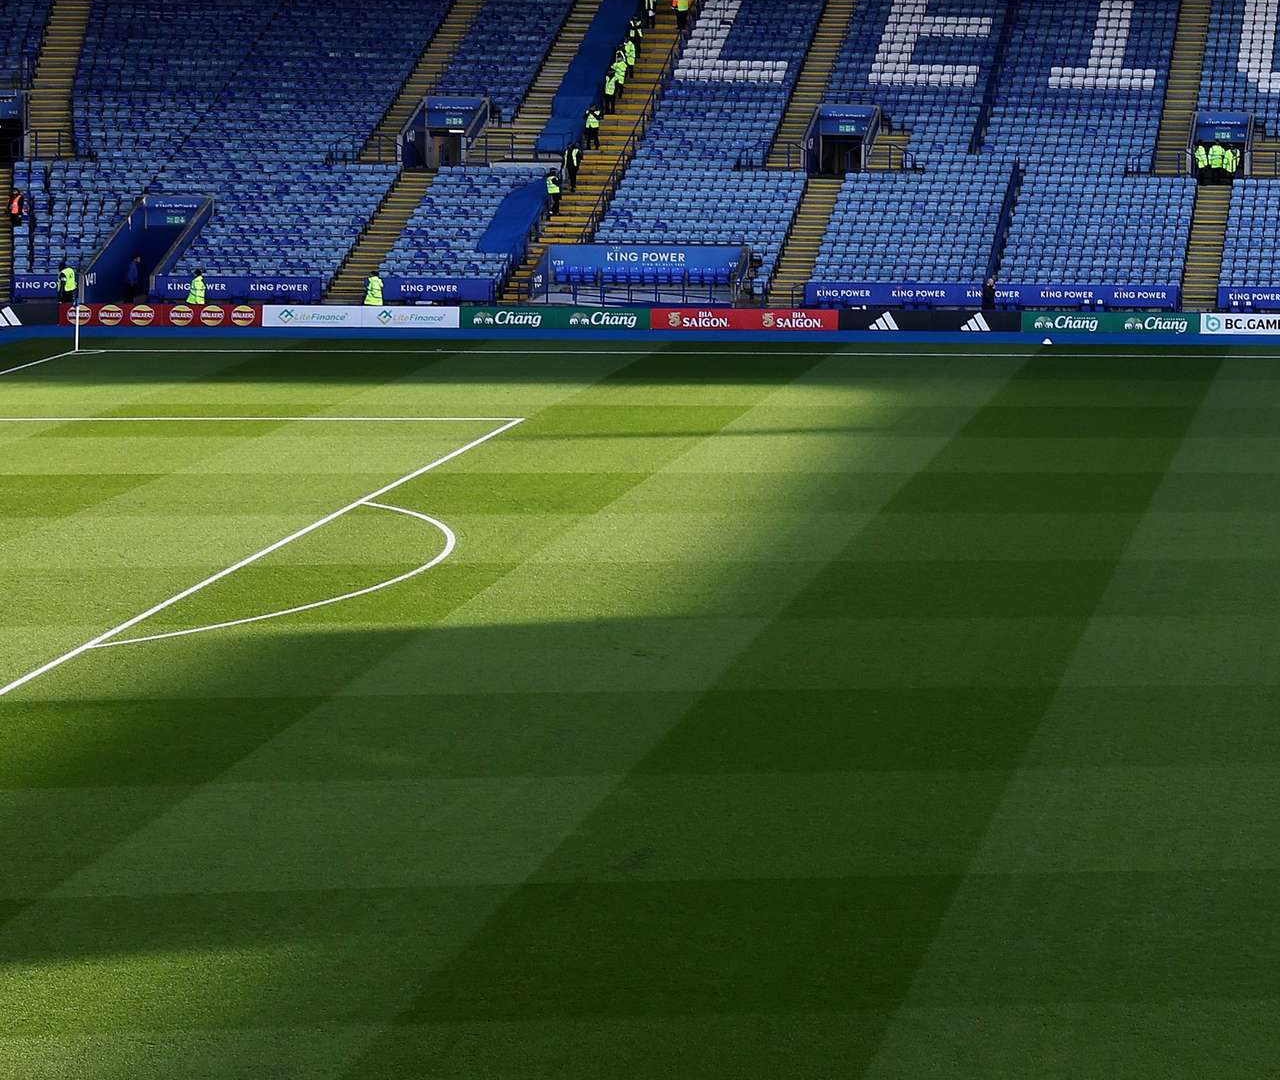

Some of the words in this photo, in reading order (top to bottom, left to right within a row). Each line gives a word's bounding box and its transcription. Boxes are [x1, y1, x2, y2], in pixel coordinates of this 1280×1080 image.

[607, 252, 638, 262] KING
[643, 253, 685, 262] POWER
[494, 311, 542, 327] Chang
[590, 312, 637, 328] Chang
[1055, 316, 1098, 332] Chang
[1144, 317, 1188, 334] Chang
